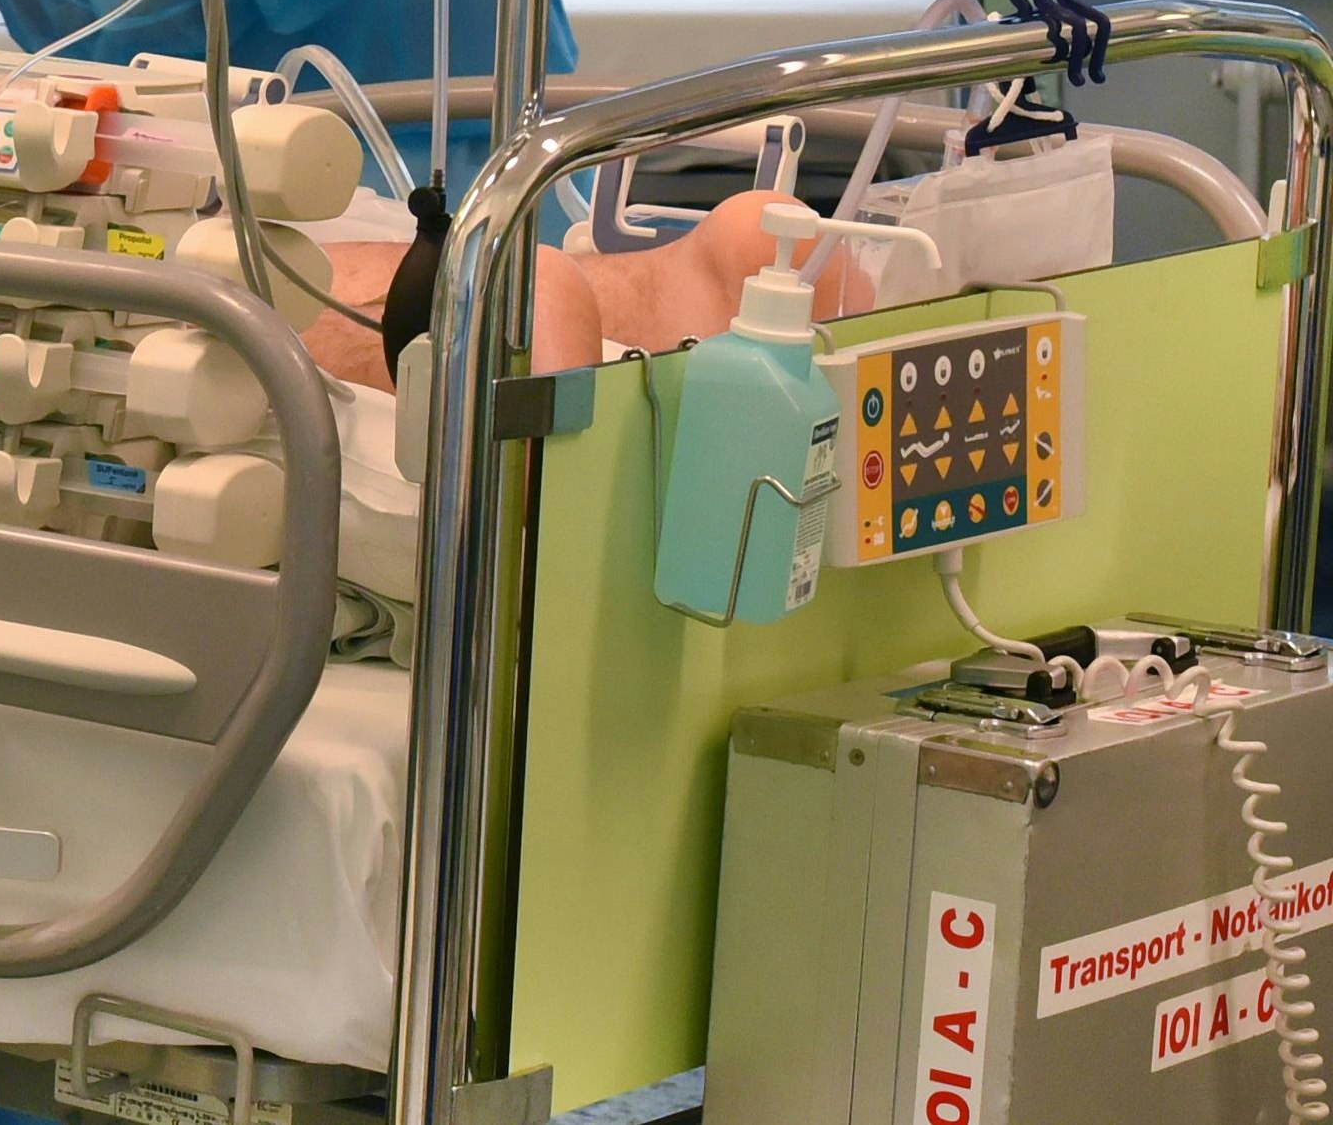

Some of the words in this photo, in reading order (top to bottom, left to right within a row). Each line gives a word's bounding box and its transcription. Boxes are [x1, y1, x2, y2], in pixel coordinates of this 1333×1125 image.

[940, 908, 985, 950] C
[1050, 920, 1186, 994] Transport
[933, 1010, 977, 1054] A
[1209, 993, 1230, 1041] A
